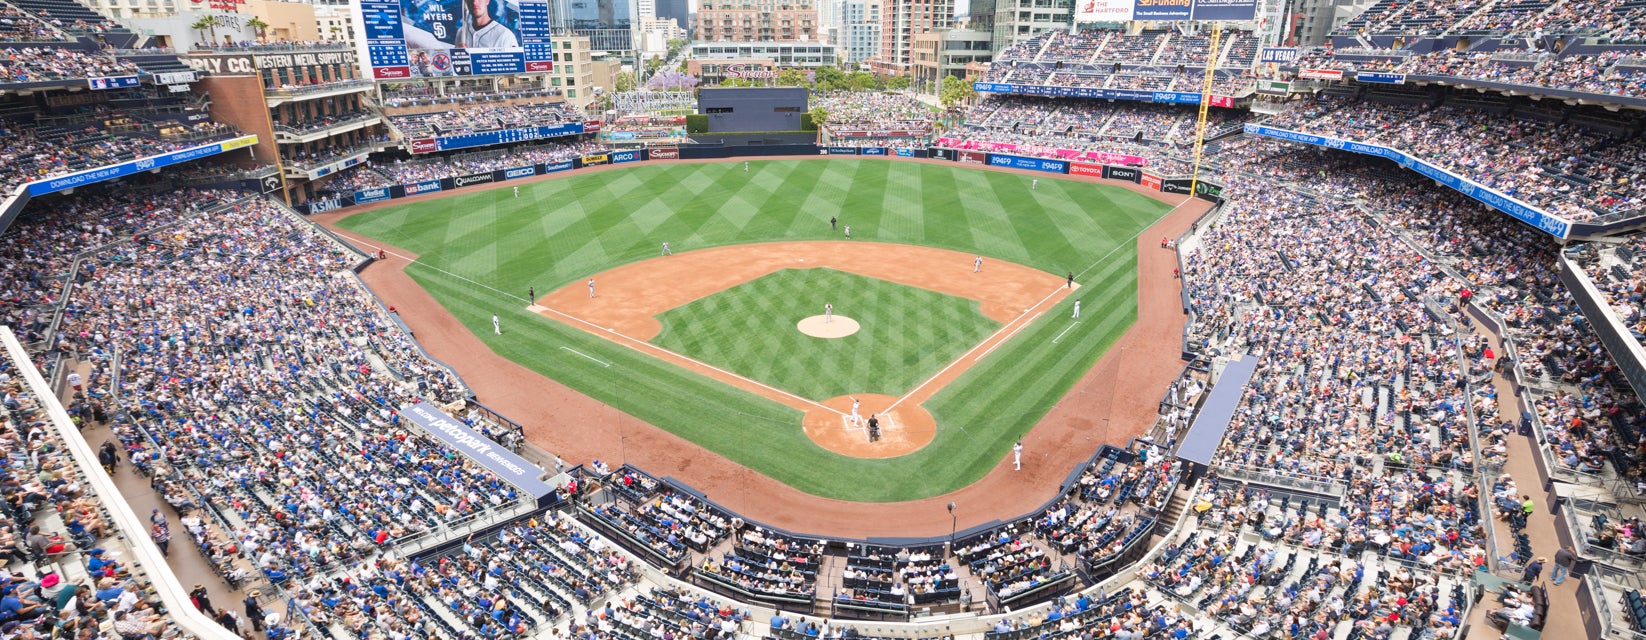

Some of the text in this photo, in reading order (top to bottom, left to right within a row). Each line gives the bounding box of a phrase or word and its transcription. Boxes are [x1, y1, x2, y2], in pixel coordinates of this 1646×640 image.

[428, 4, 446, 12] WIL
[423, 13, 453, 21] MYERS
[254, 54, 294, 69] WESTERN
[294, 53, 319, 67] METAL
[318, 52, 342, 65] SUPPLY
[343, 51, 355, 63] CO.
[1262, 50, 1295, 62] LAS VEGAS
[226, 58, 257, 74] CO.
[728, 64, 778, 82] Sycuan
[610, 91, 693, 102] NATIONAL
[412, 141, 435, 151] Sycuan
[1264, 128, 1289, 139] DOWNLOAD
[1289, 131, 1298, 140] THE
[1308, 135, 1318, 143] APP
[1350, 143, 1383, 155] DOWNLOAD
[614, 153, 633, 161] ARCO
[652, 150, 676, 158] Sycuan
[50, 174, 86, 189] DOWNLOAD
[84, 171, 97, 182] THE
[96, 169, 109, 179] NEW
[108, 167, 120, 177] APP
[172, 151, 195, 161] DOWNLOAD
[194, 149, 202, 158] THE
[202, 147, 211, 156] NEW
[547, 162, 569, 171] Southwest
[1079, 166, 1101, 174] TOYOTA
[506, 167, 534, 178] GEICO
[1112, 170, 1135, 178] SONY
[455, 174, 492, 187] QUALCOMM
[310, 199, 342, 214] ASML
[1478, 189, 1504, 207] DOWNLOAD
[1503, 200, 1514, 212] THE
[1513, 204, 1525, 217] NEW
[1524, 209, 1536, 221] APP
[412, 406, 438, 422] WELCOME
[486, 450, 526, 476] BIENVENIDOS
